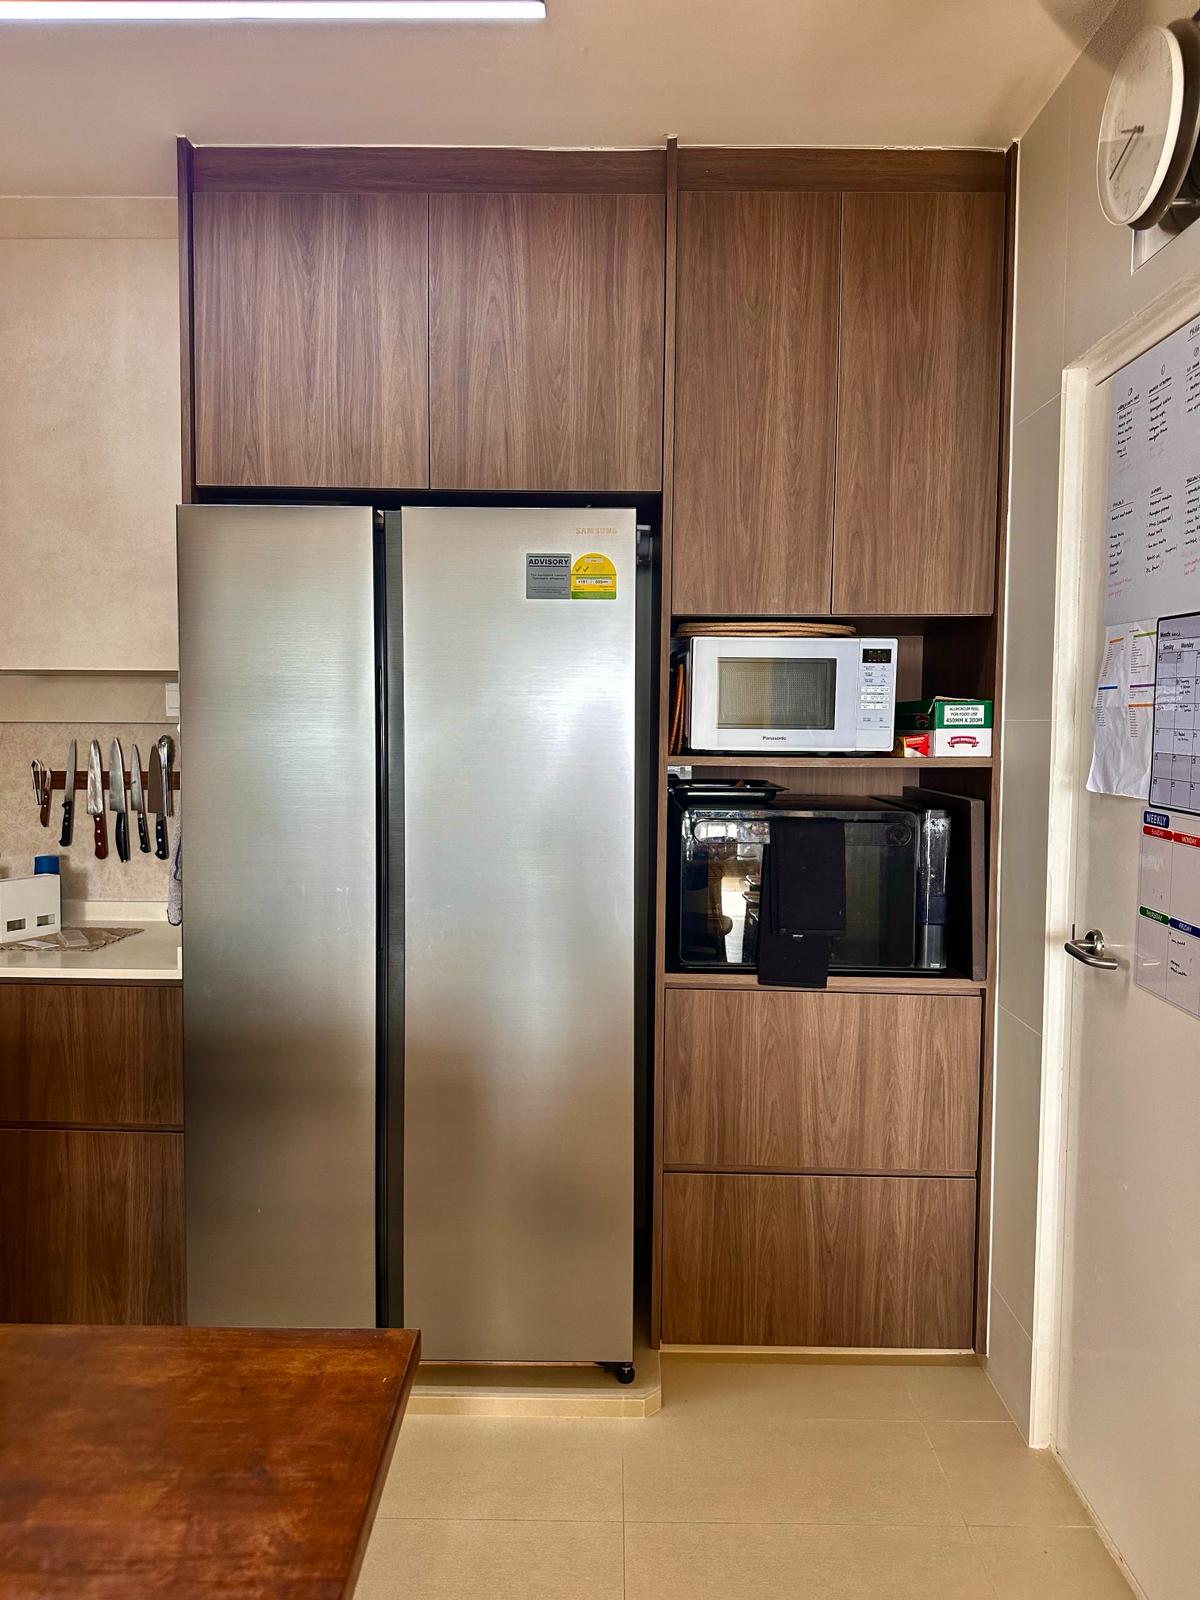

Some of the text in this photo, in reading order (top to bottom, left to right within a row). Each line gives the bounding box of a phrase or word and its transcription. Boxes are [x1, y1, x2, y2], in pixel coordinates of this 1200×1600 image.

[575, 527, 618, 535] SAMSUNG
[528, 558, 569, 566] ADVISORY
[1146, 812, 1167, 826] WEEKLY
[1181, 836, 1198, 845] MONDAY
[1178, 922, 1192, 933] FRIDAY
